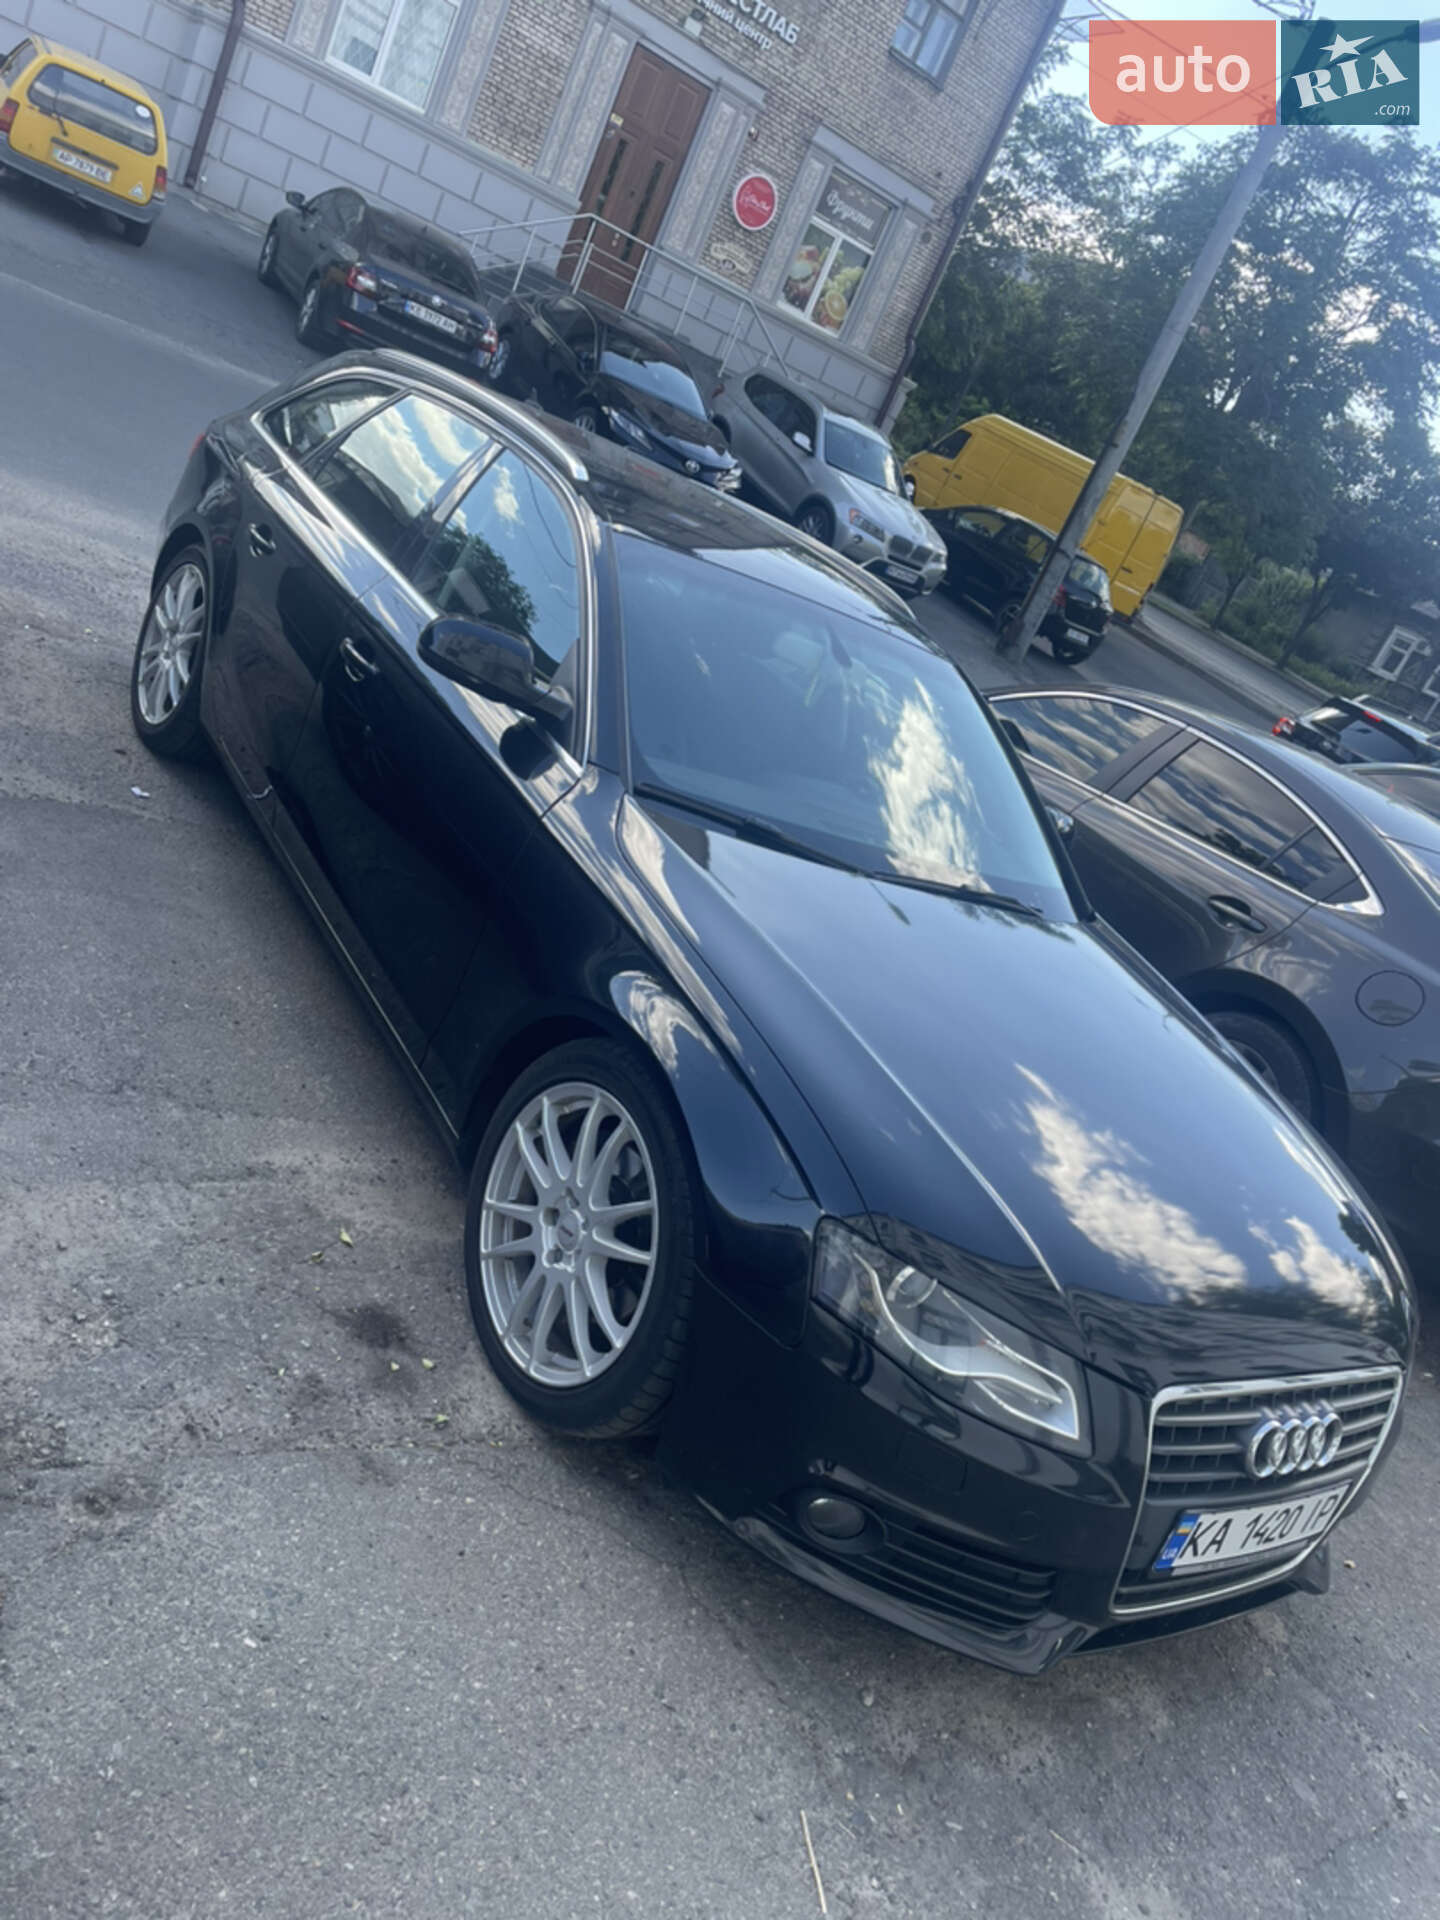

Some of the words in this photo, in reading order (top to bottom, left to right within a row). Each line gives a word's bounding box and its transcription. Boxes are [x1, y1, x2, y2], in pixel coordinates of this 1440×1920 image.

[697, 0, 735, 24] чний
[735, 18, 773, 50] центр
[729, 0, 800, 45] СТЛАБ
[1179, 1518, 1233, 1559] KA
[1240, 1505, 1304, 1549] 1420
[1300, 1494, 1339, 1534] IP
